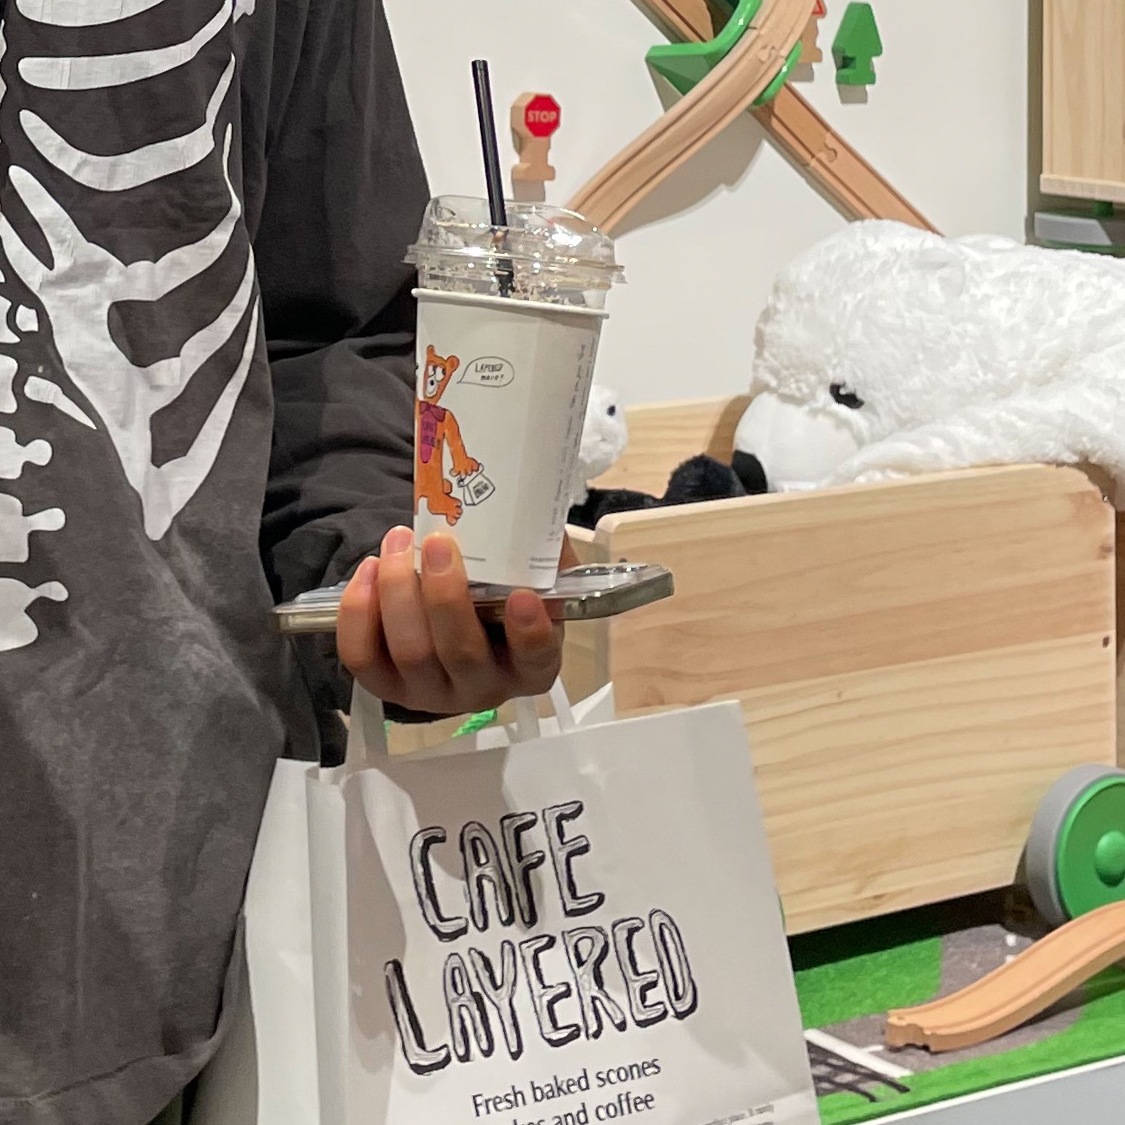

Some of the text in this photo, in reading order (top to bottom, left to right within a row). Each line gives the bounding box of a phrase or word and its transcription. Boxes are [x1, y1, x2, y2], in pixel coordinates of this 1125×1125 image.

[527, 110, 557, 123] STOP
[409, 800, 605, 941] CAFE
[384, 909, 698, 1076] LAYERED
[472, 1058, 662, 1117] Fresh baked scones
[552, 1091, 655, 1125] and coffee
